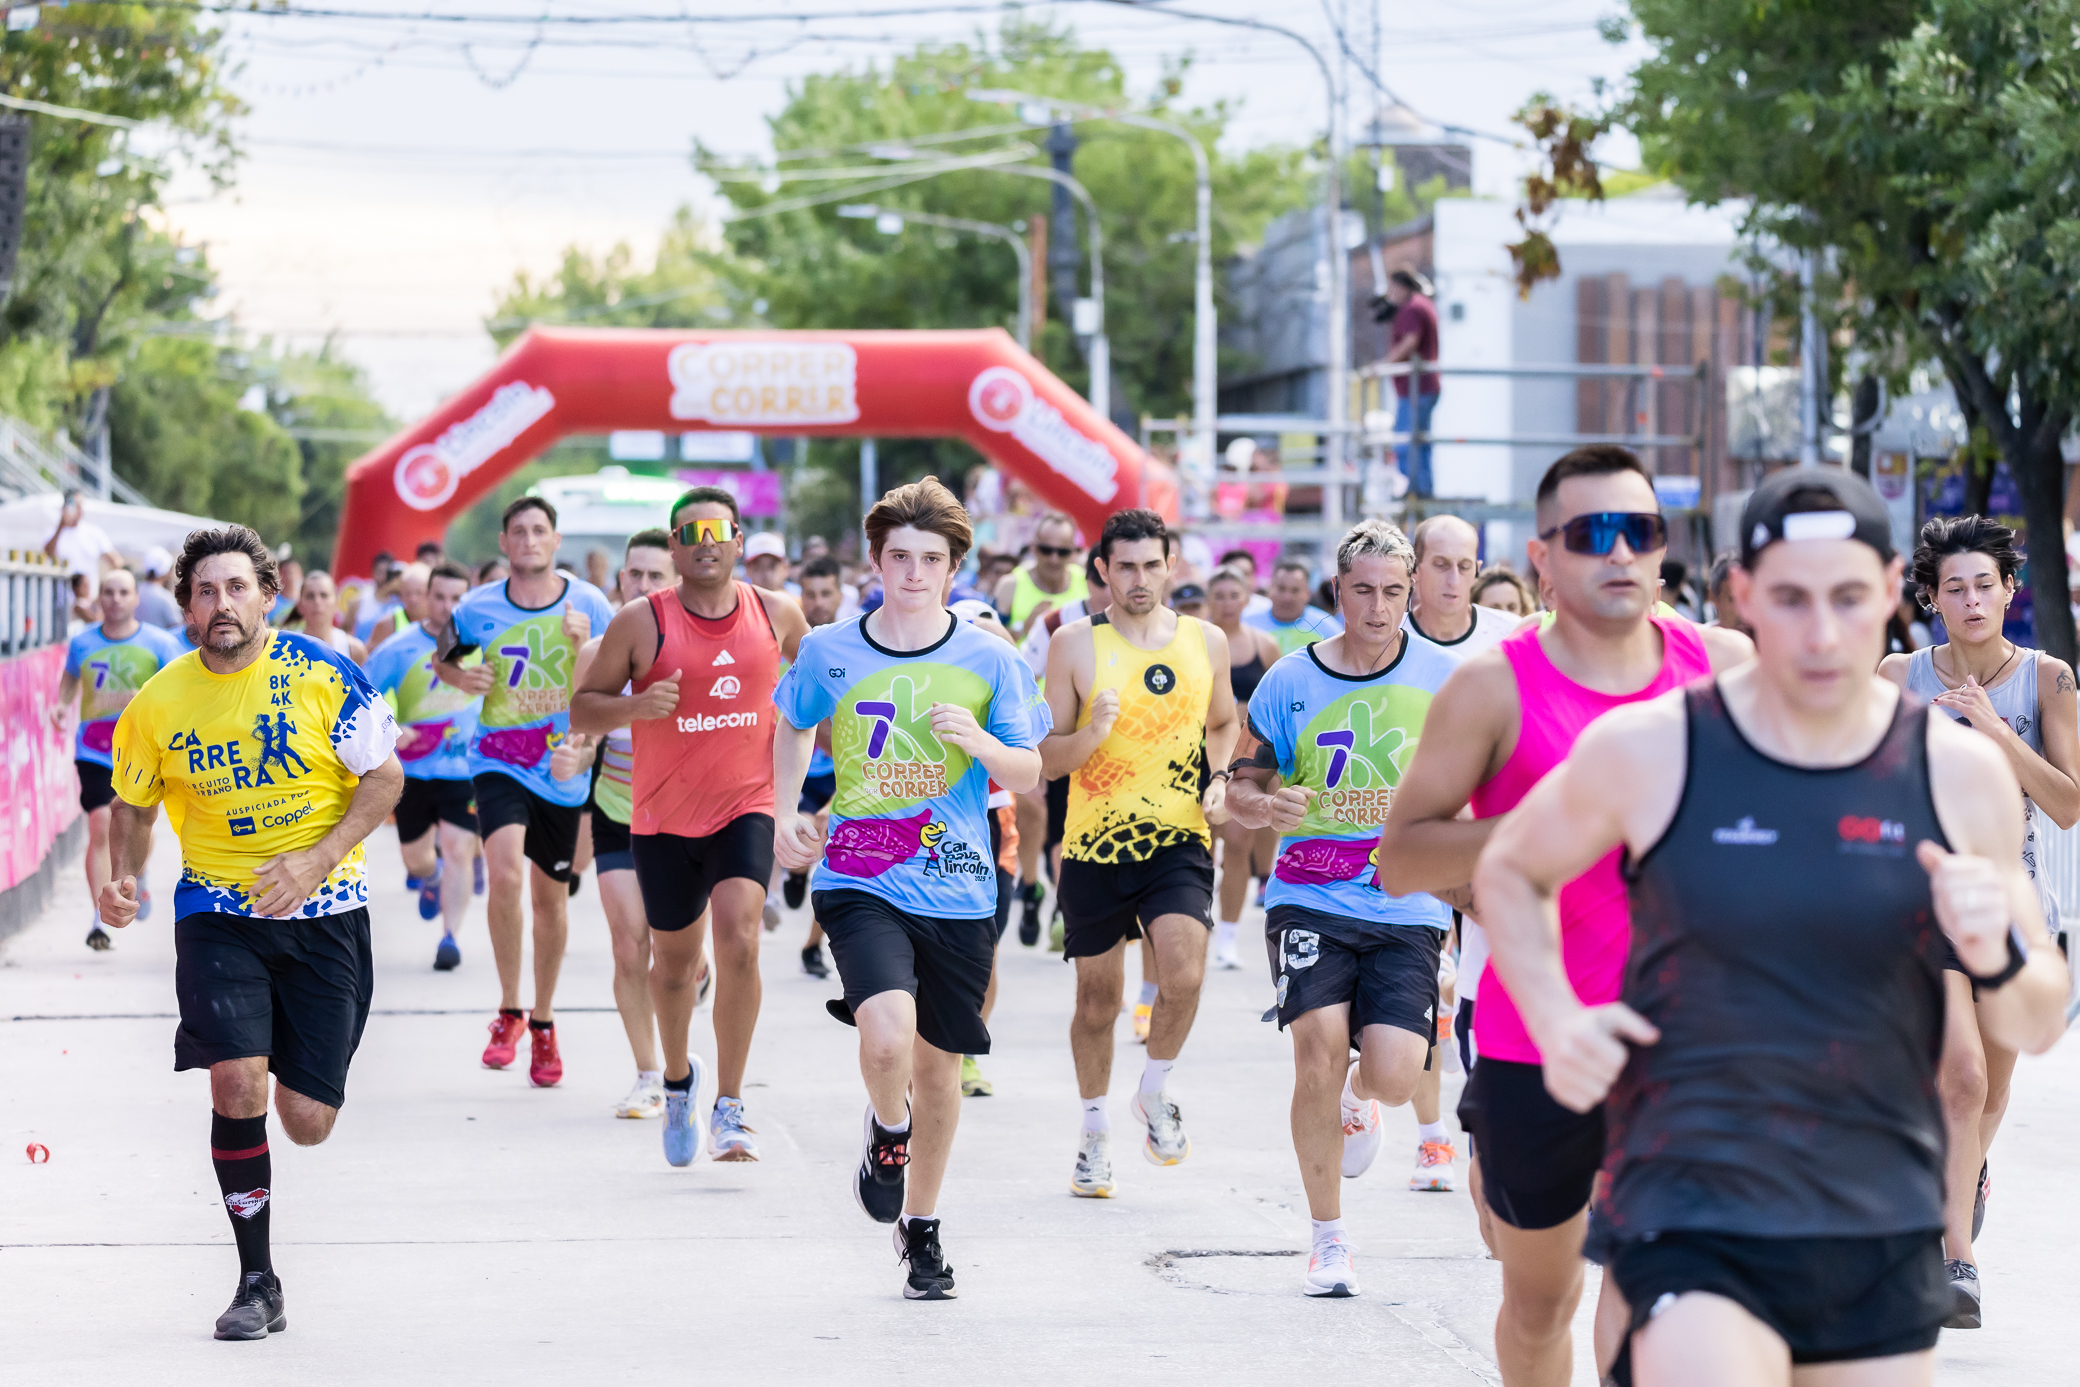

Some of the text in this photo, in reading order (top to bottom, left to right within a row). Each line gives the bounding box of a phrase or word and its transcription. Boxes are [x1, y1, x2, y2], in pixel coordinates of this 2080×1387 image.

[269, 674, 291, 690] 8K
[270, 690, 293, 706] 4K
[677, 712, 757, 733] telecom
[188, 740, 243, 774] RRE
[232, 764, 275, 790] RA
[861, 761, 946, 781] CORRER
[879, 780, 949, 799] CORRER
[226, 798, 287, 816] AUSPICIADA
[262, 800, 316, 827] Coppel
[1333, 808, 1389, 825] CORRE
[941, 841, 968, 854] Car
